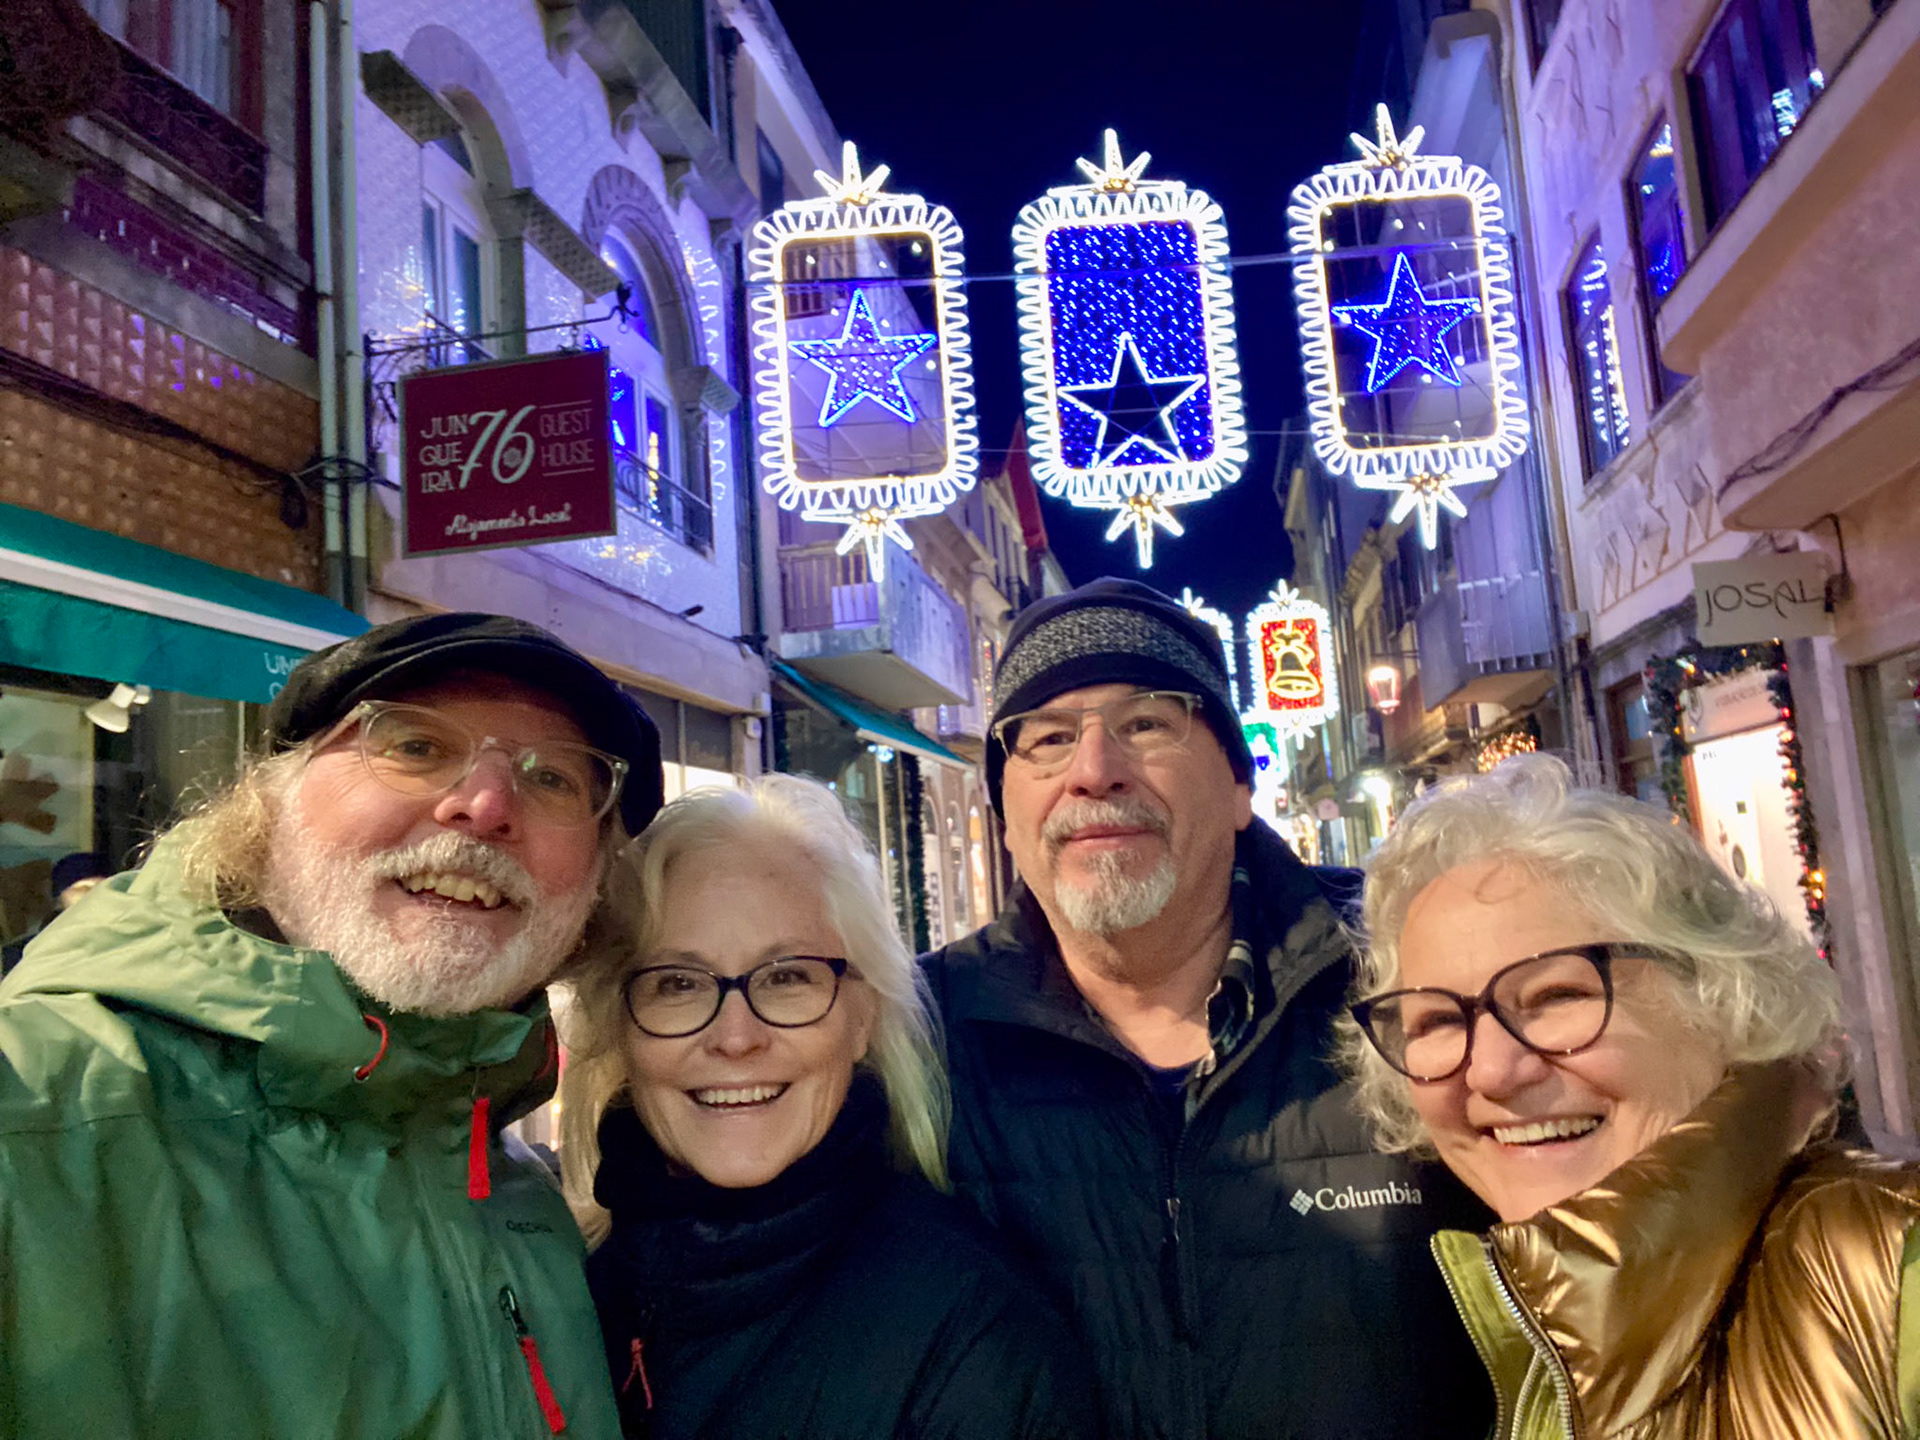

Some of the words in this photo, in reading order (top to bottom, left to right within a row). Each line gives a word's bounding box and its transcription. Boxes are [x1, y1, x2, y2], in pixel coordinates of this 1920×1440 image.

[420, 413, 468, 439] JUN
[540, 408, 593, 438] GUEST
[419, 441, 463, 466] QUE
[458, 405, 537, 489] 76
[541, 438, 595, 468] HOUSE
[421, 469, 455, 493] IRA
[1704, 579, 1824, 627] JOSAL
[1315, 1181, 1422, 1211] Columbia
